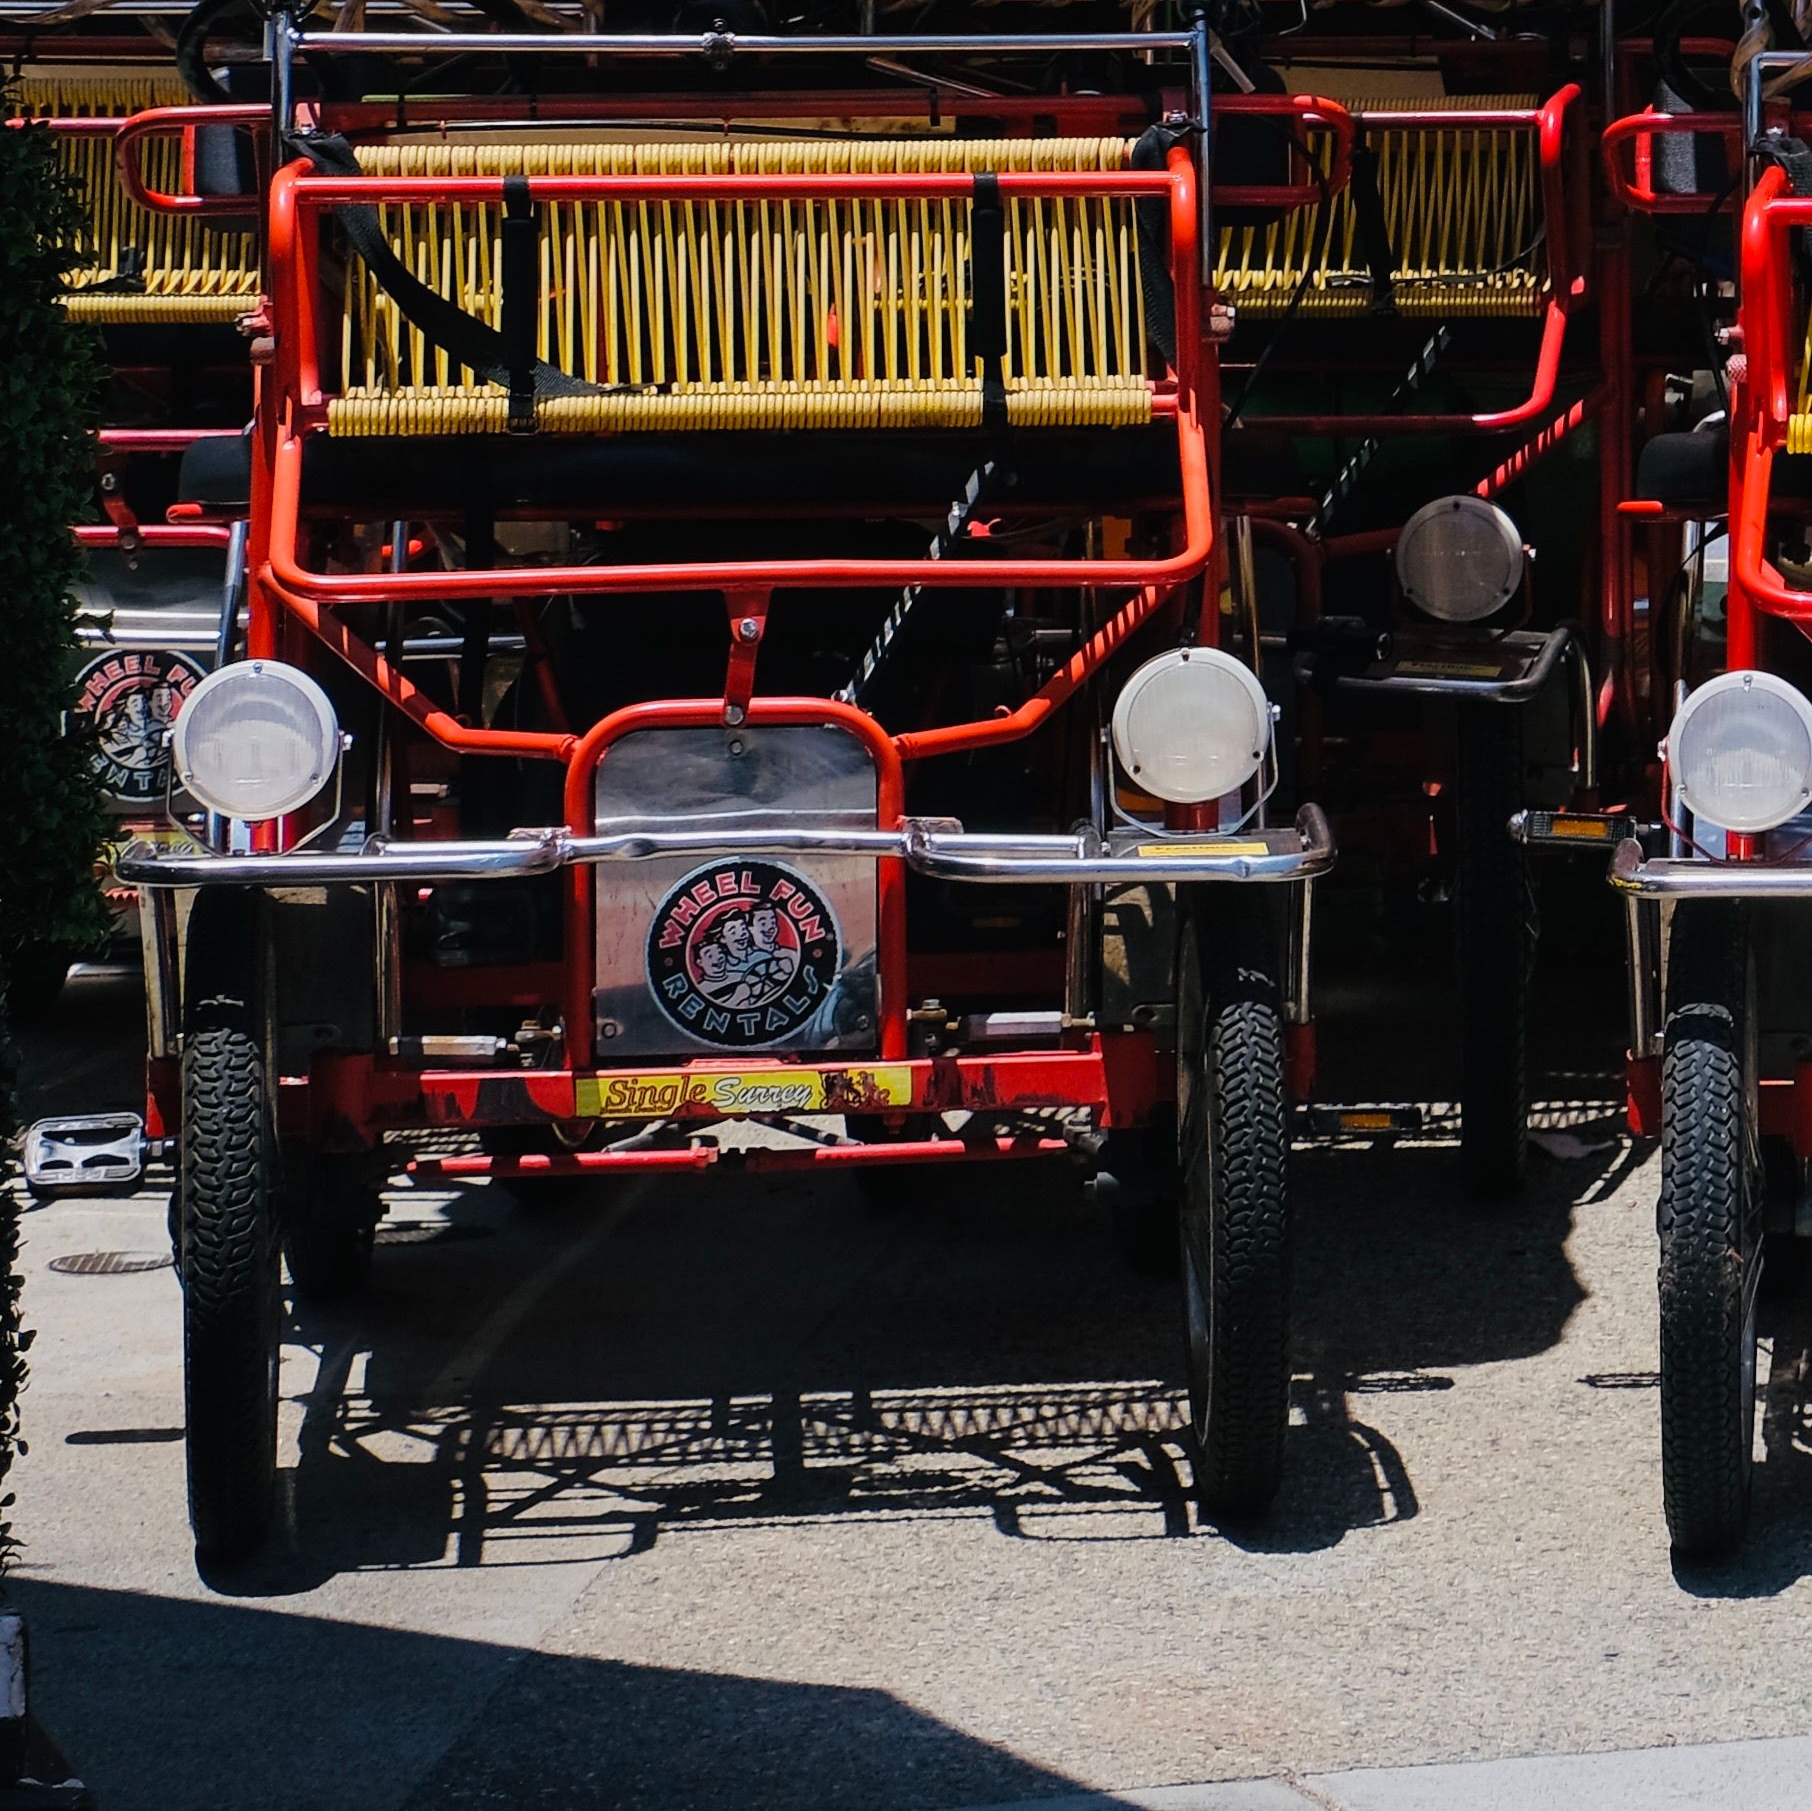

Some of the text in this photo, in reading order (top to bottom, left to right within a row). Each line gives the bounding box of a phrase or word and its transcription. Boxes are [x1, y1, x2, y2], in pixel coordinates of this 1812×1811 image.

[659, 871, 826, 948] WHEEL FUN
[662, 965, 819, 1035] RENTALS
[605, 1075, 813, 1110] Single Surrey
